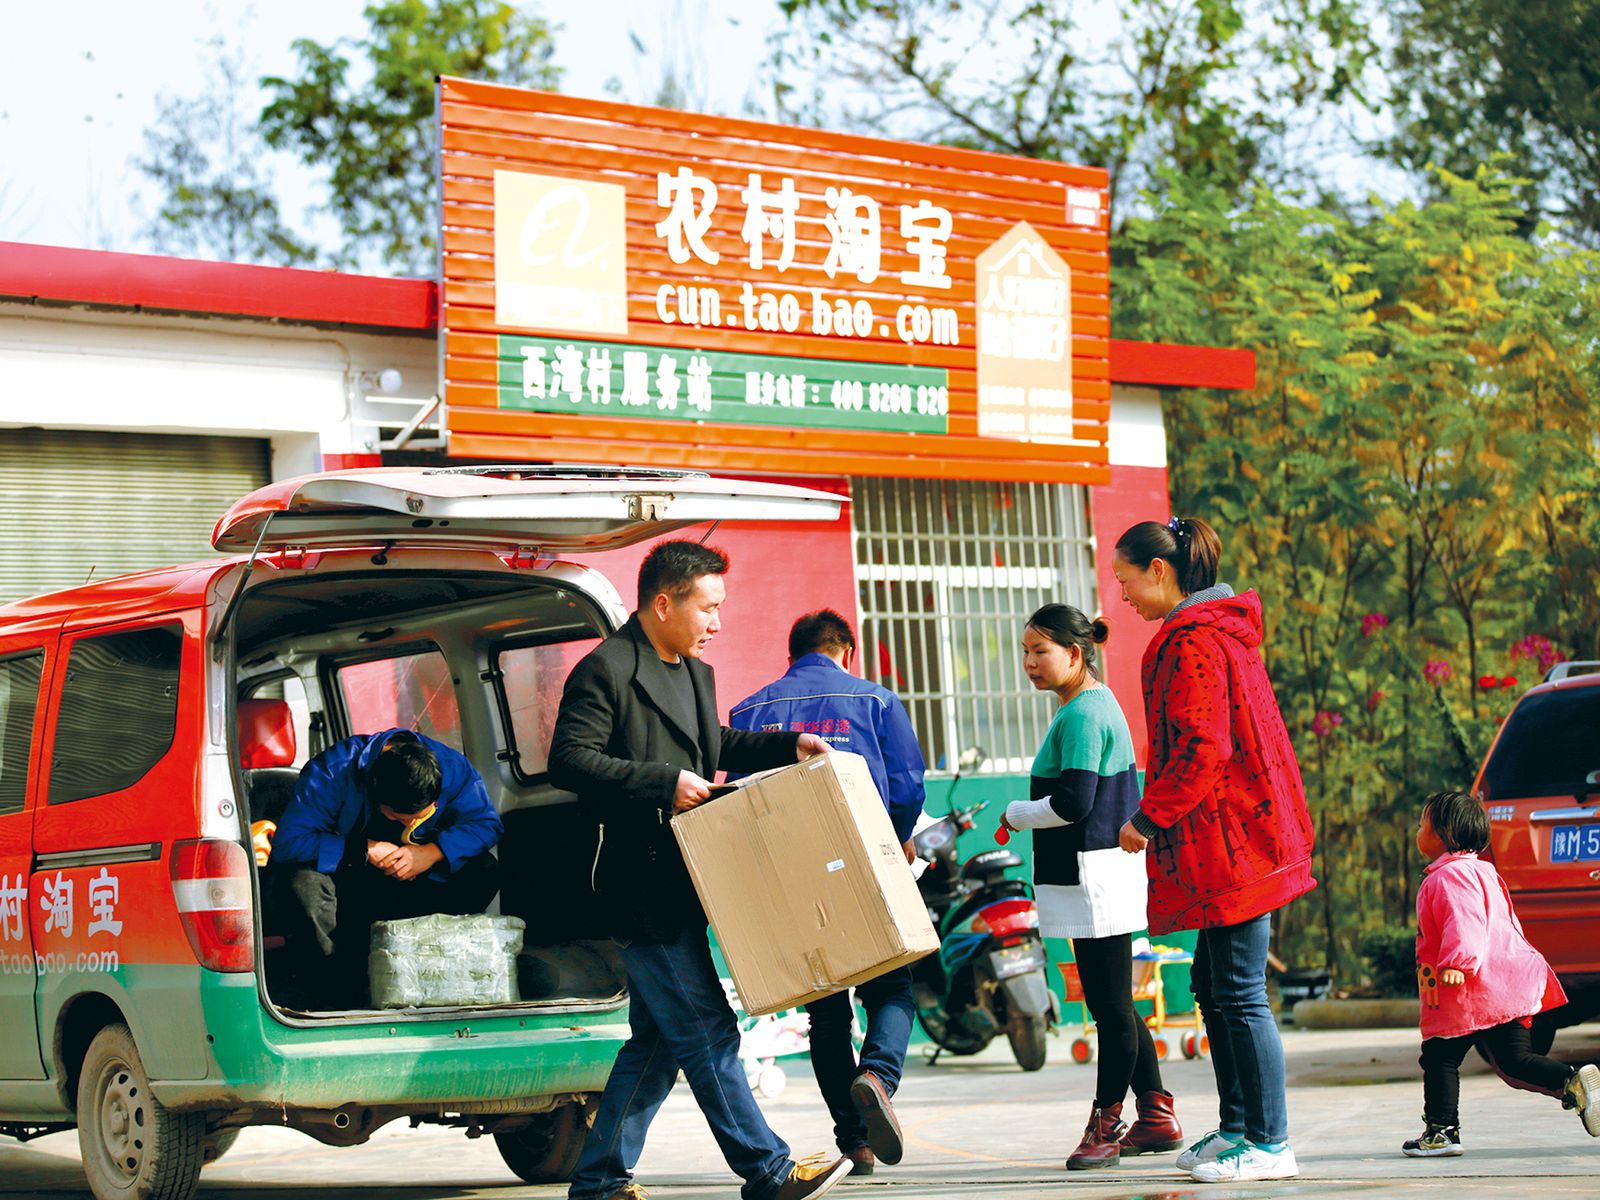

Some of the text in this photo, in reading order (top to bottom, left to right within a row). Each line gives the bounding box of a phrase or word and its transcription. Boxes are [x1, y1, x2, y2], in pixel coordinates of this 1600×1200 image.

[655, 166, 954, 290] 农村淘宝
[0, 867, 123, 941] 村淘宝
